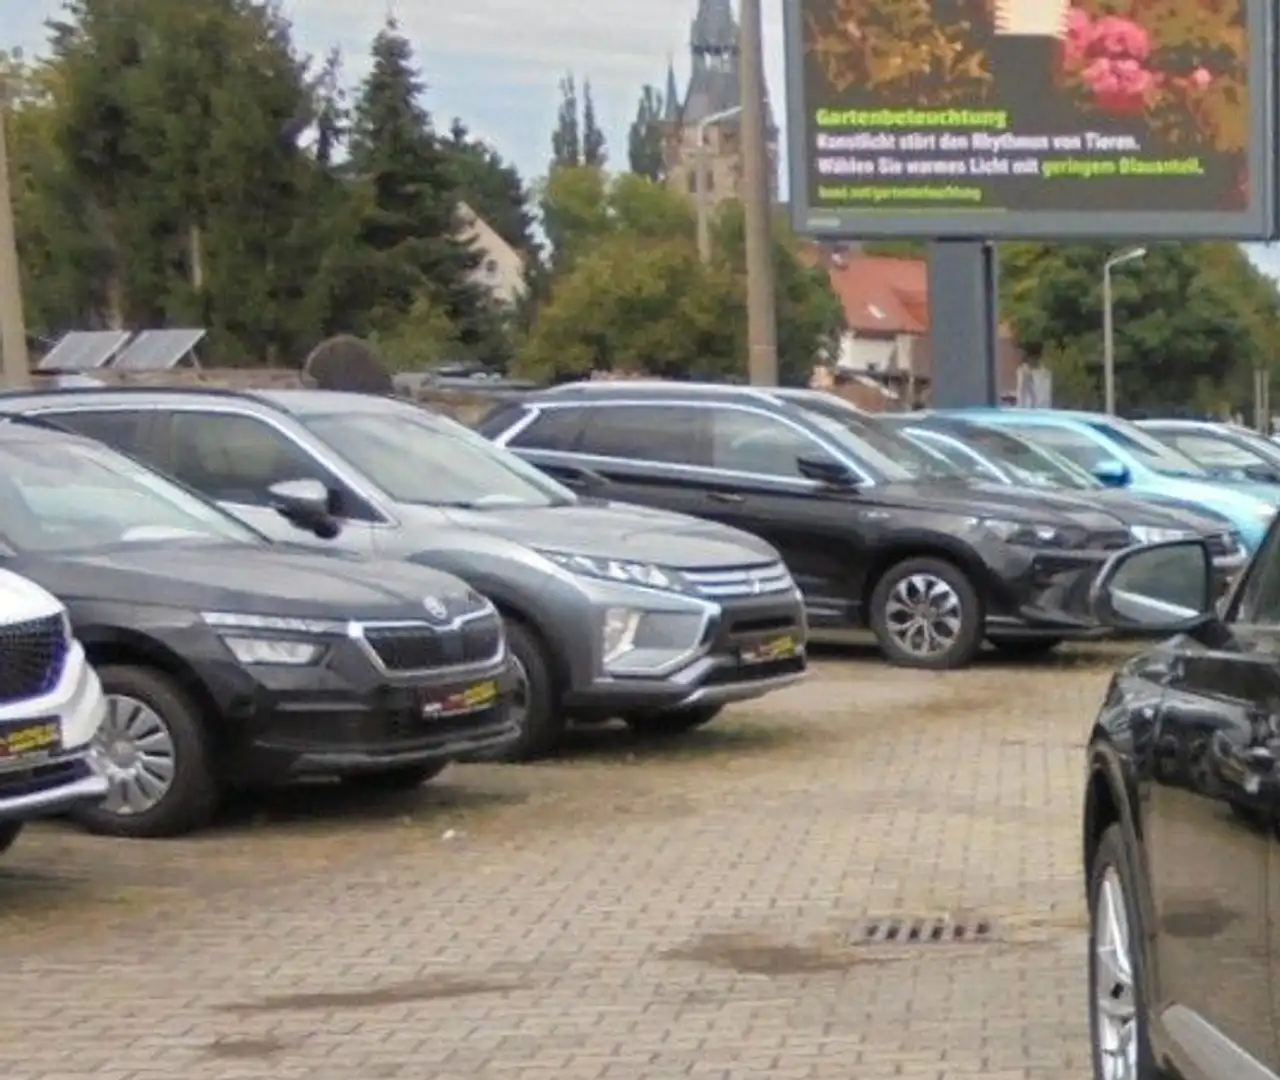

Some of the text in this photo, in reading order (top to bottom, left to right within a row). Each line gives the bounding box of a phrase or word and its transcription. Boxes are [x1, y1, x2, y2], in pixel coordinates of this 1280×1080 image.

[816, 110, 1007, 128] Gartenbeleuchtung
[939, 133, 969, 150] den
[972, 132, 1049, 152] Rhythmus
[1053, 136, 1081, 150] von
[1084, 132, 1141, 150] Tieren.
[877, 156, 903, 174] Sie
[969, 157, 1009, 174] Licht
[1012, 157, 1039, 174] mit
[1042, 158, 1116, 178] geringem
